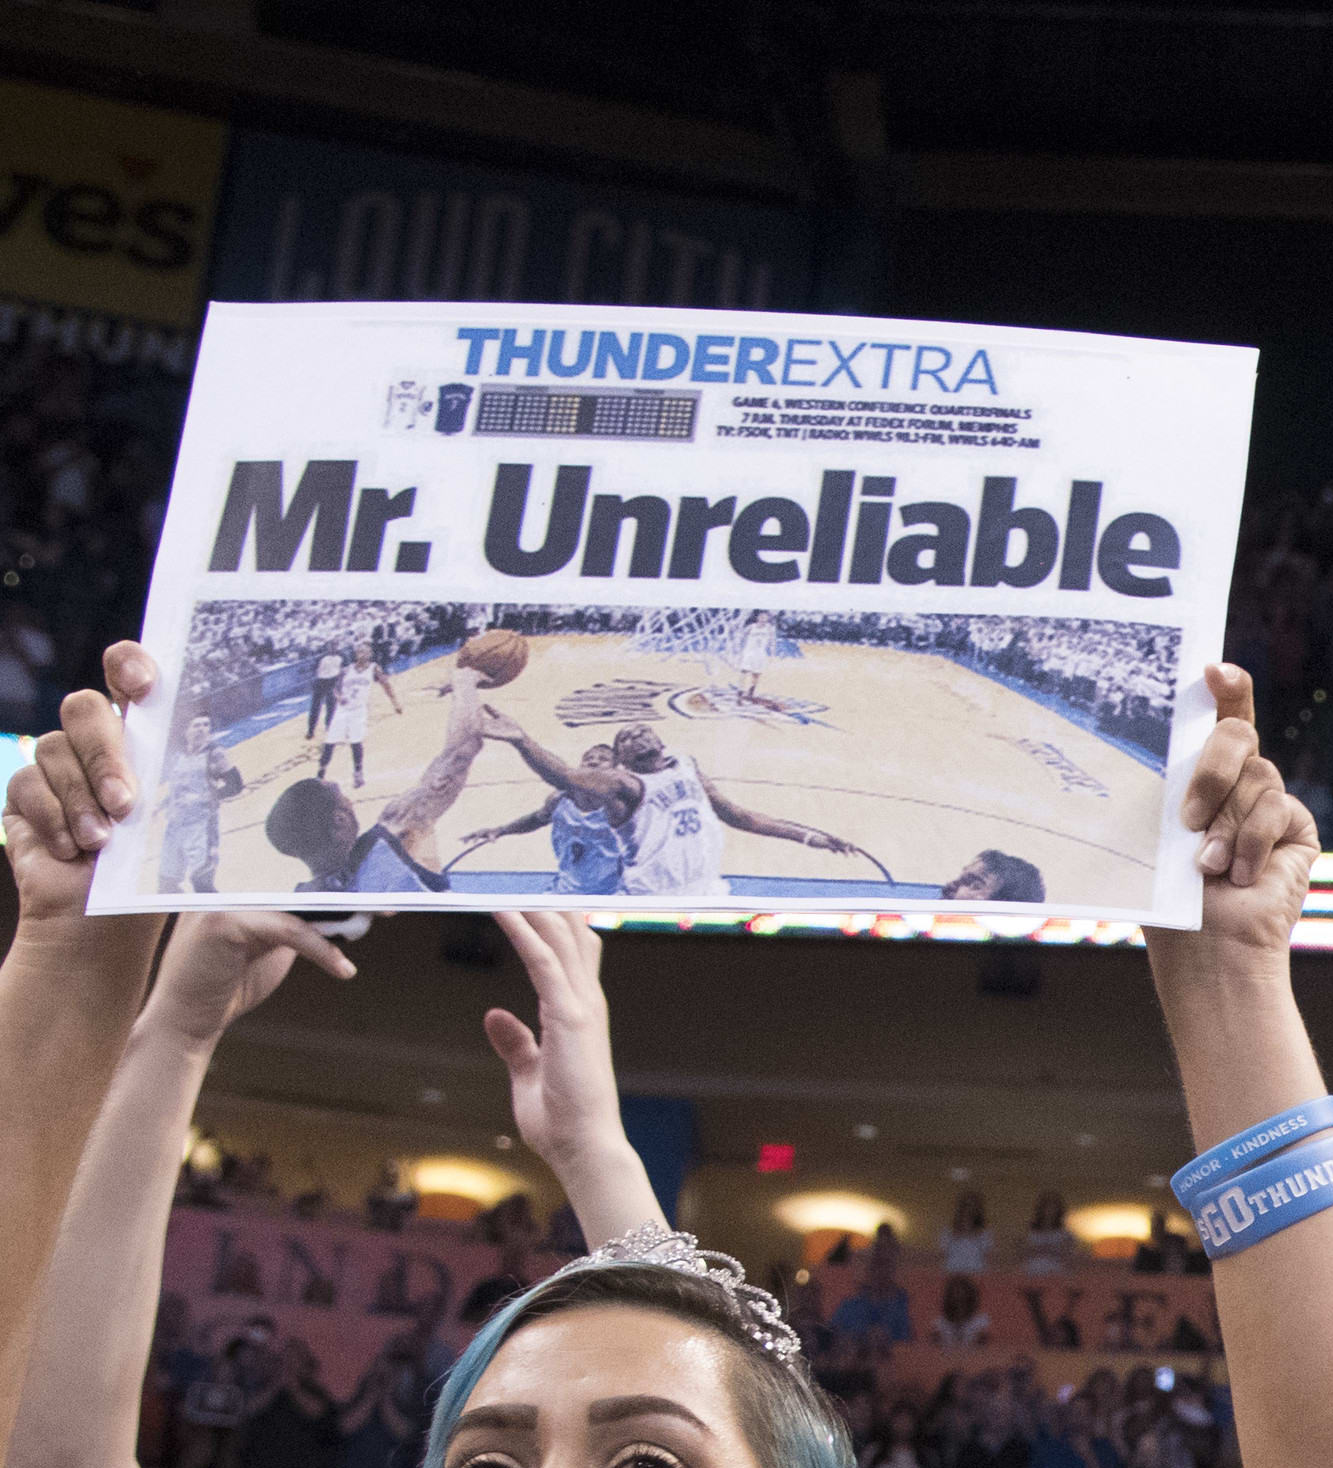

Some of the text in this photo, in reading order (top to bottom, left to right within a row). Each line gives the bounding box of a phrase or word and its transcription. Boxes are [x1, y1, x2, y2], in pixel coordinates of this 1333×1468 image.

[732, 396, 769, 408] GAME
[784, 398, 846, 411] WESTERN
[847, 401, 928, 415] CONFERENCE
[930, 404, 1032, 420] QUARTERFINALS
[776, 427, 800, 439] TNT
[780, 413, 846, 426] THURSDAY
[846, 415, 861, 427] AT
[864, 416, 905, 429] FEDEX
[958, 421, 1018, 434] MEMPHIS
[208, 459, 1182, 599] Mr. Unreliable
[1178, 1114, 1309, 1194] HONOR KINDNESS
